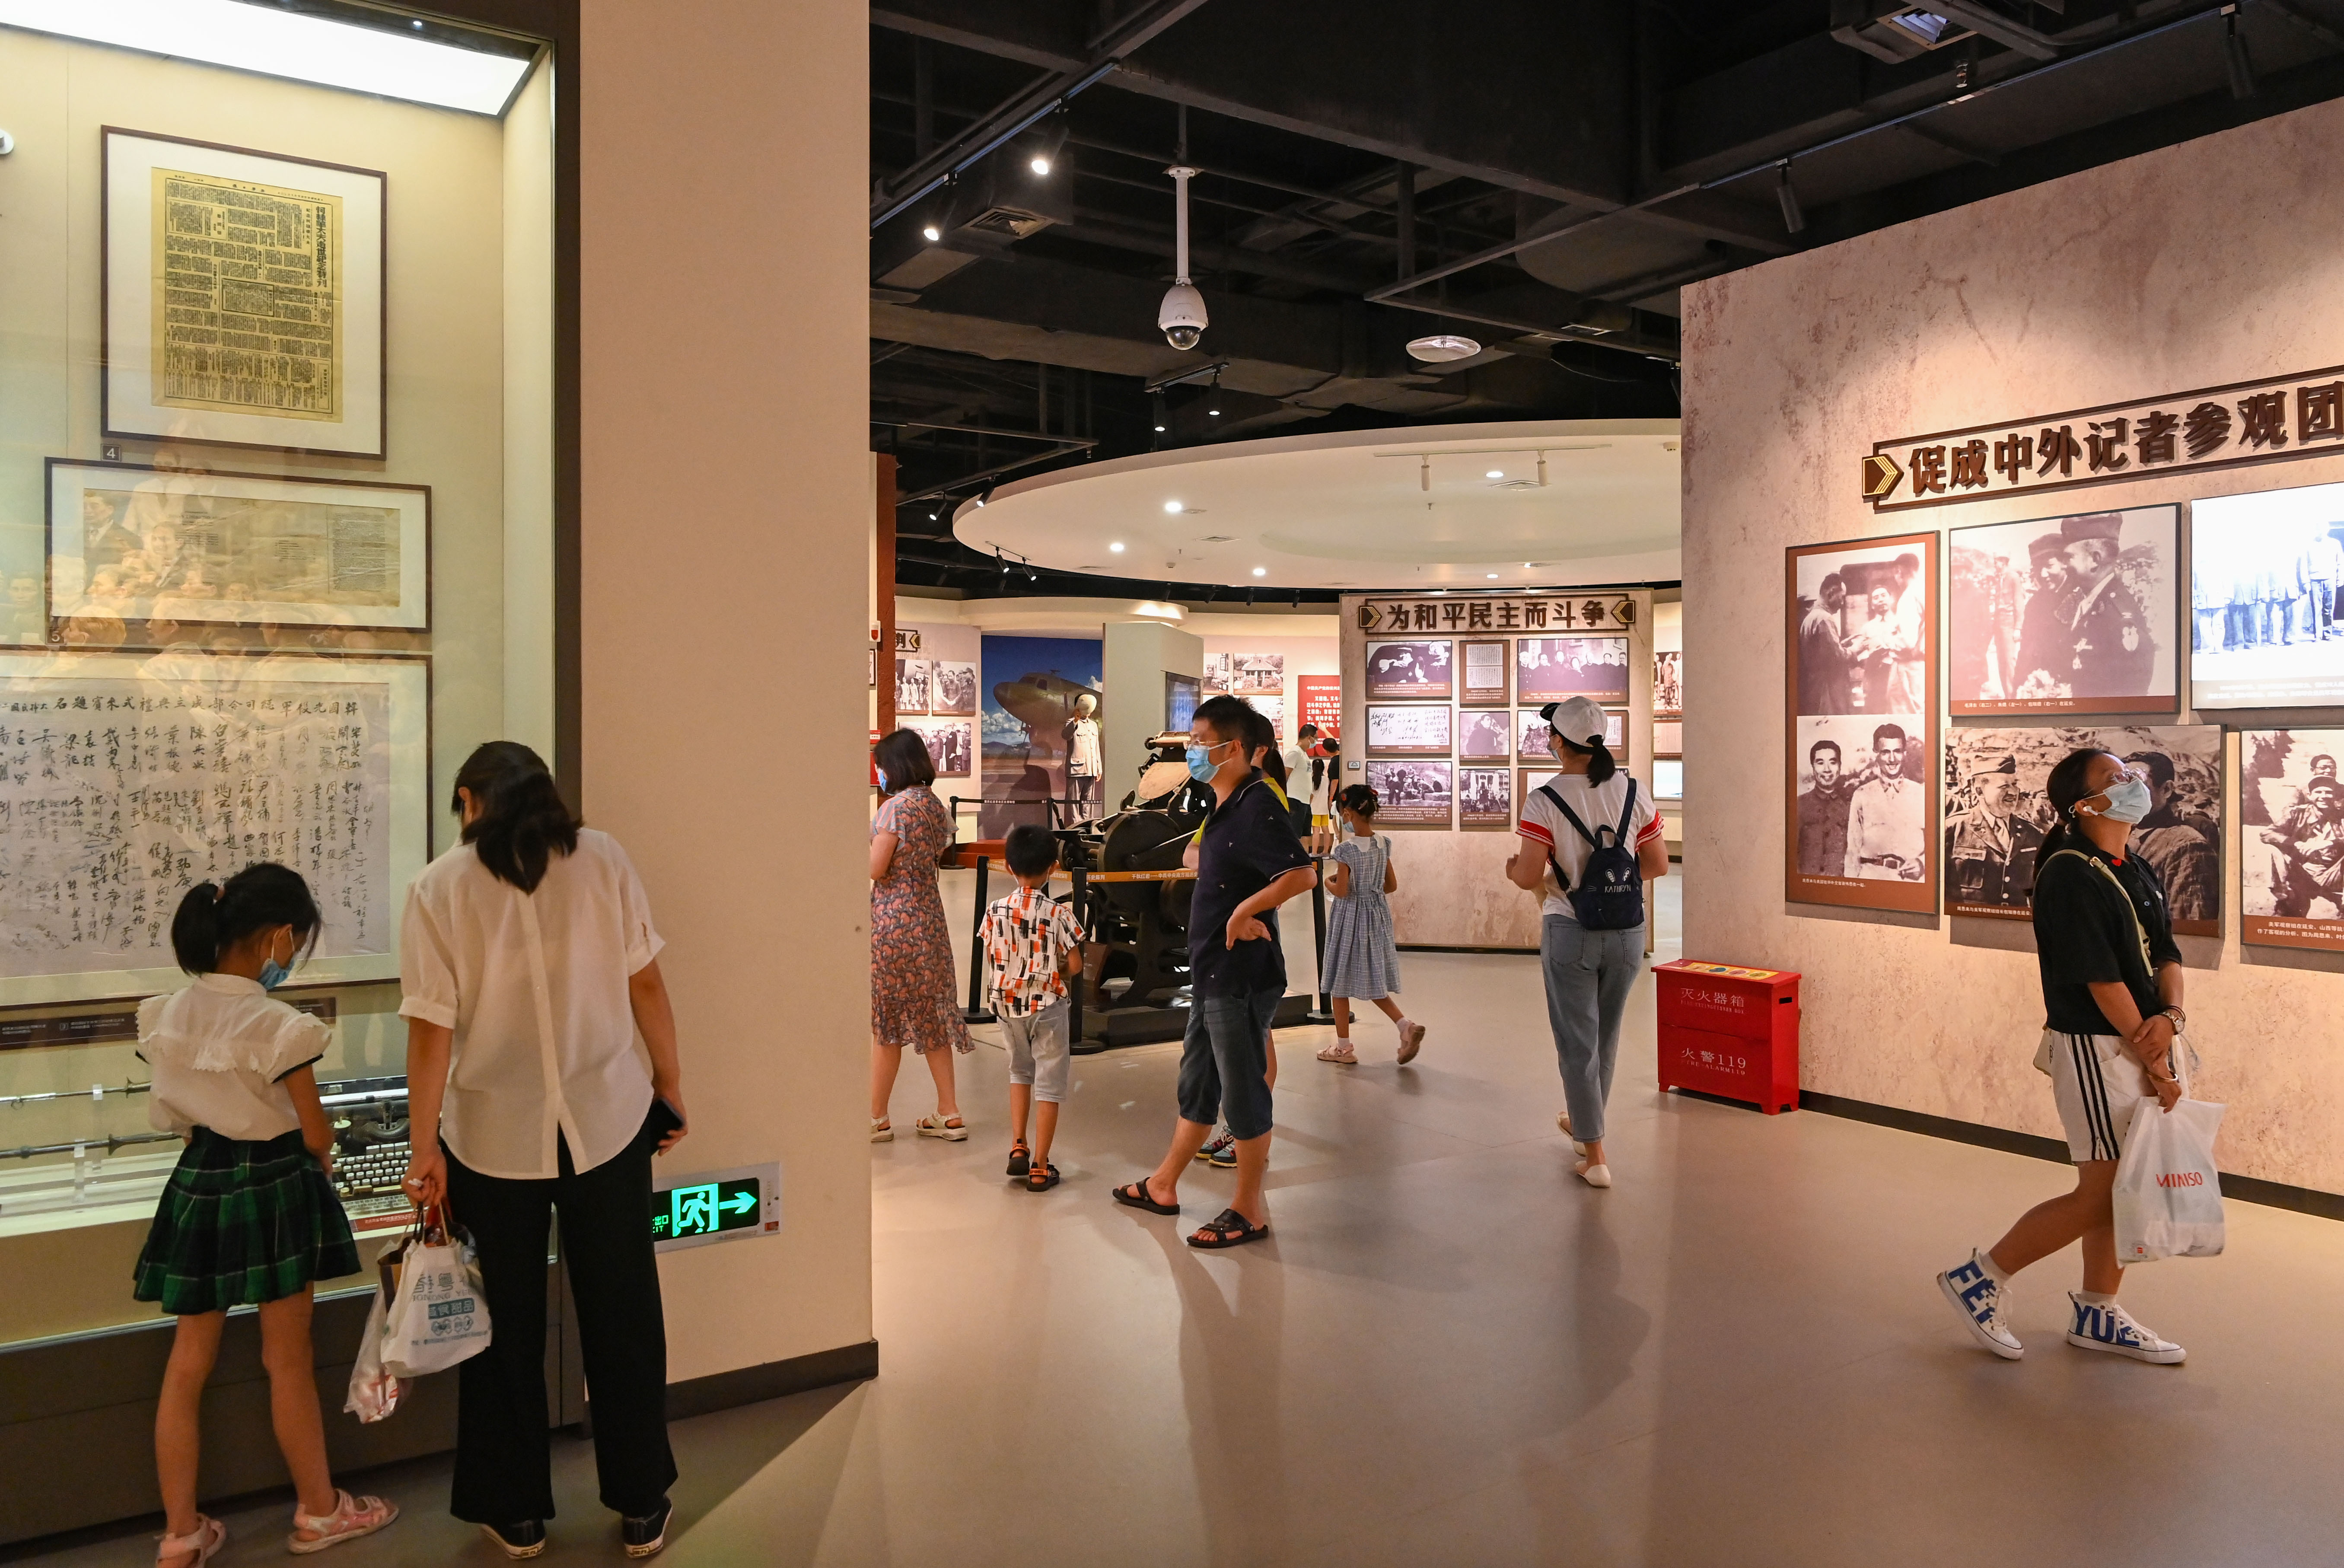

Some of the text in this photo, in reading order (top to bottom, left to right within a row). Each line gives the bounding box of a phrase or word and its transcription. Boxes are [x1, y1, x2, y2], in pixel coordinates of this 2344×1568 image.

[1909, 380, 2344, 495] 促成中外记者参观团
[107, 448, 116, 459] 4
[1387, 600, 1605, 630] 为和平民主而斗争
[51, 631, 61, 642] 5
[2268, 921, 2344, 932] 美军观察组在延安、山西等抗
[2257, 928, 2344, 940] 作了客观的分析。图为周恩来、叶
[1681, 988, 1744, 1007] 灭火器箱
[652, 1215, 669, 1226] 出口
